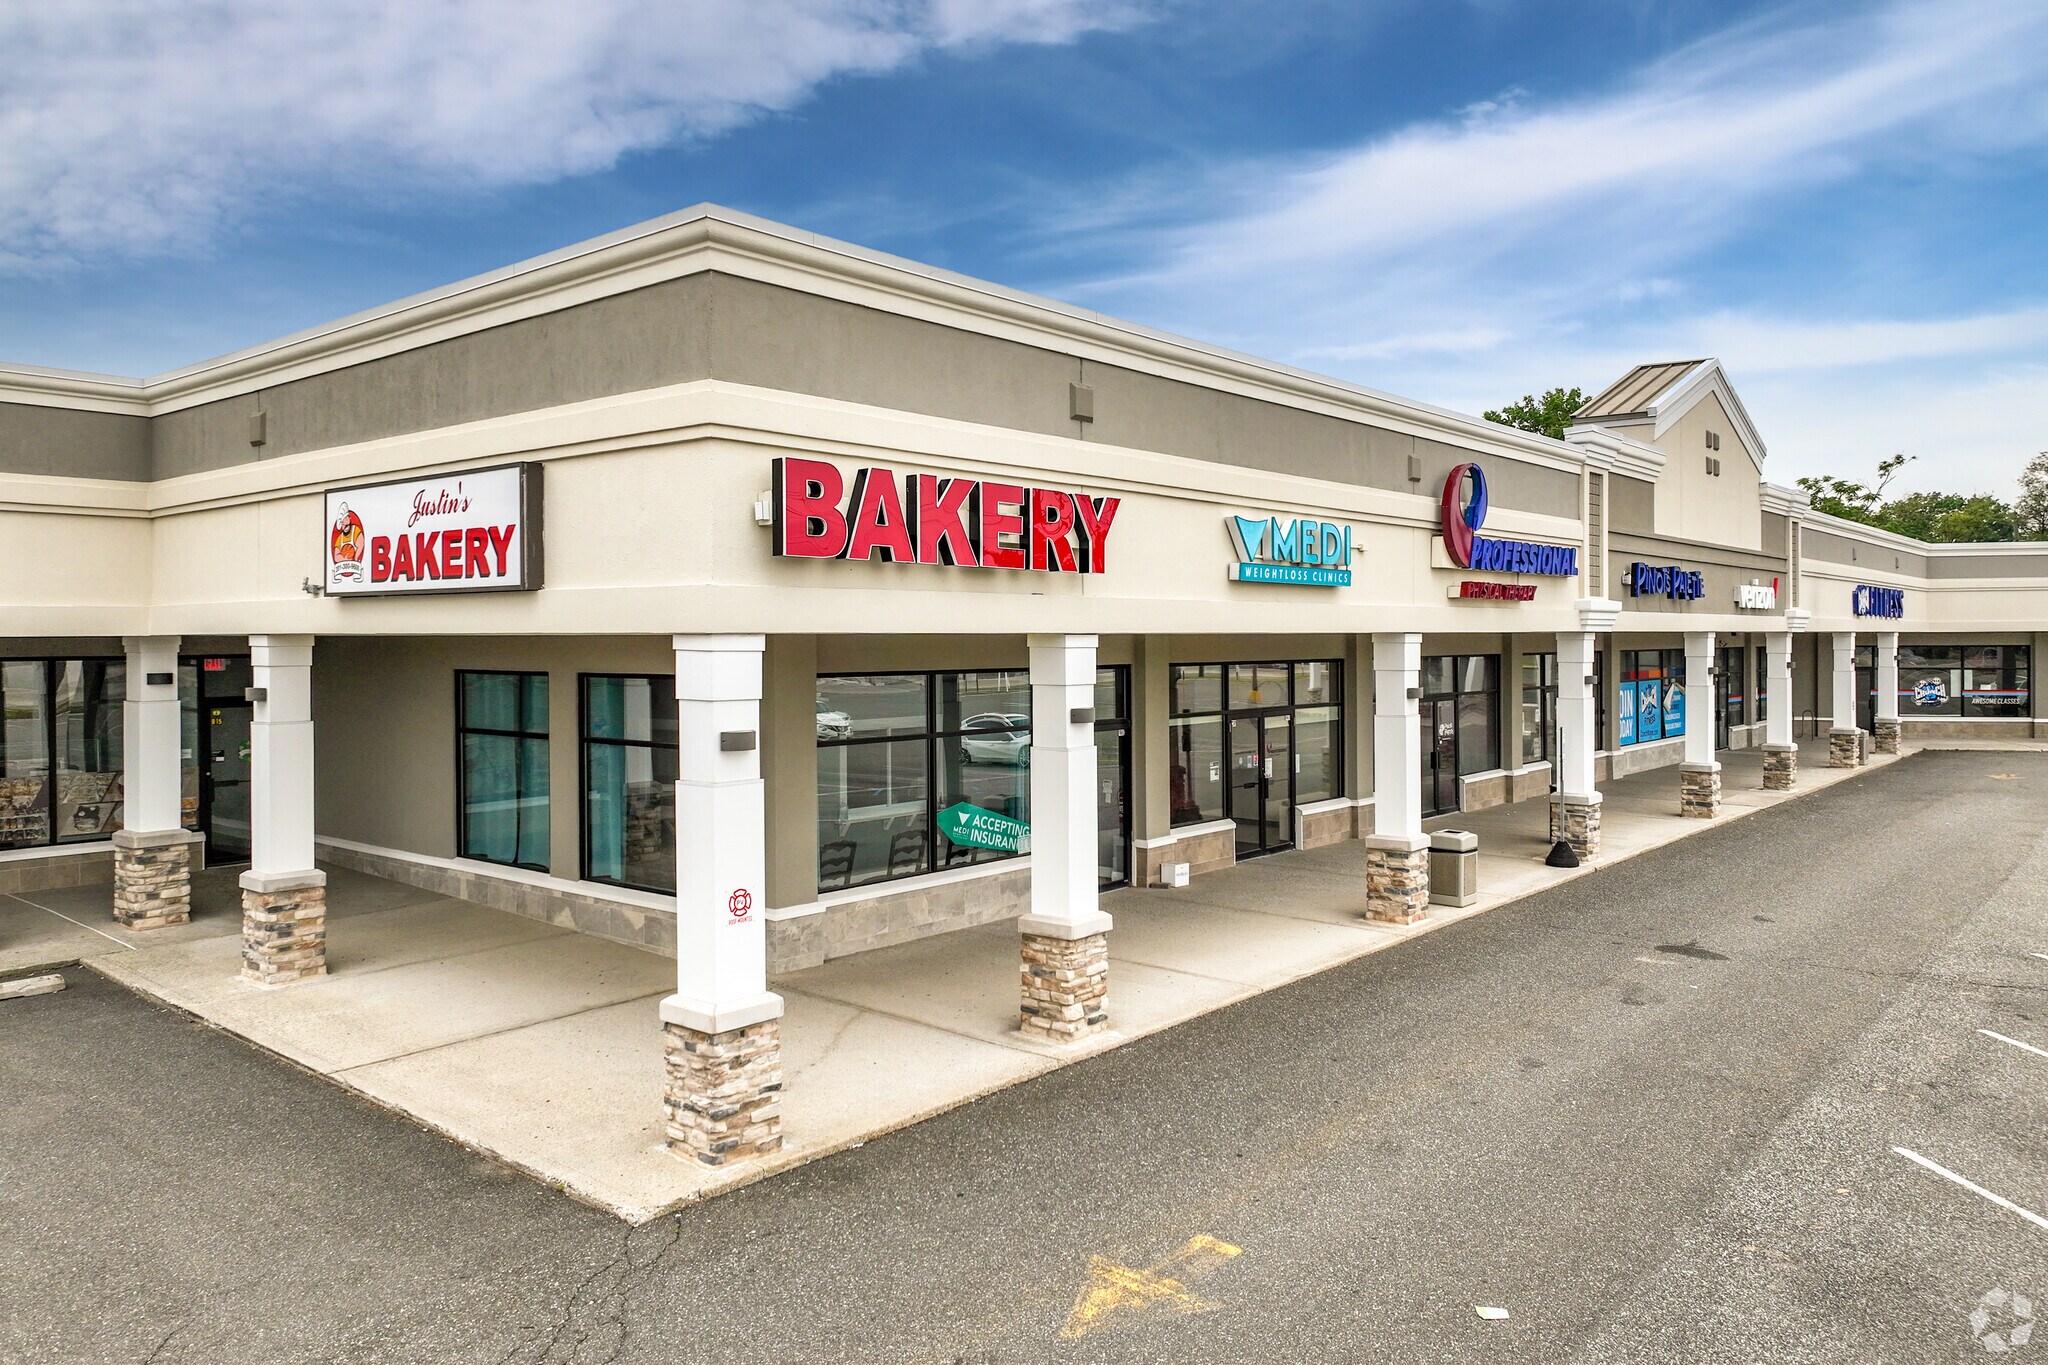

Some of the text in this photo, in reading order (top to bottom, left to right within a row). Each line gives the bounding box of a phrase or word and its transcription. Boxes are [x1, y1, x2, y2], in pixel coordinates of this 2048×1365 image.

[408, 481, 473, 527] Justin's
[780, 456, 1121, 574] BAKERY
[371, 524, 516, 583] BAKERY
[1271, 516, 1351, 566] MEDI
[1470, 536, 1578, 575] PROFESSIONAL
[1245, 566, 1348, 583] WEIGHTLOSS CLINICS
[1739, 579, 1776, 609] verizon
[1620, 690, 1633, 718] OIN
[1971, 697, 1997, 705] AWESOME
[972, 814, 1030, 836] ACCEPTING
